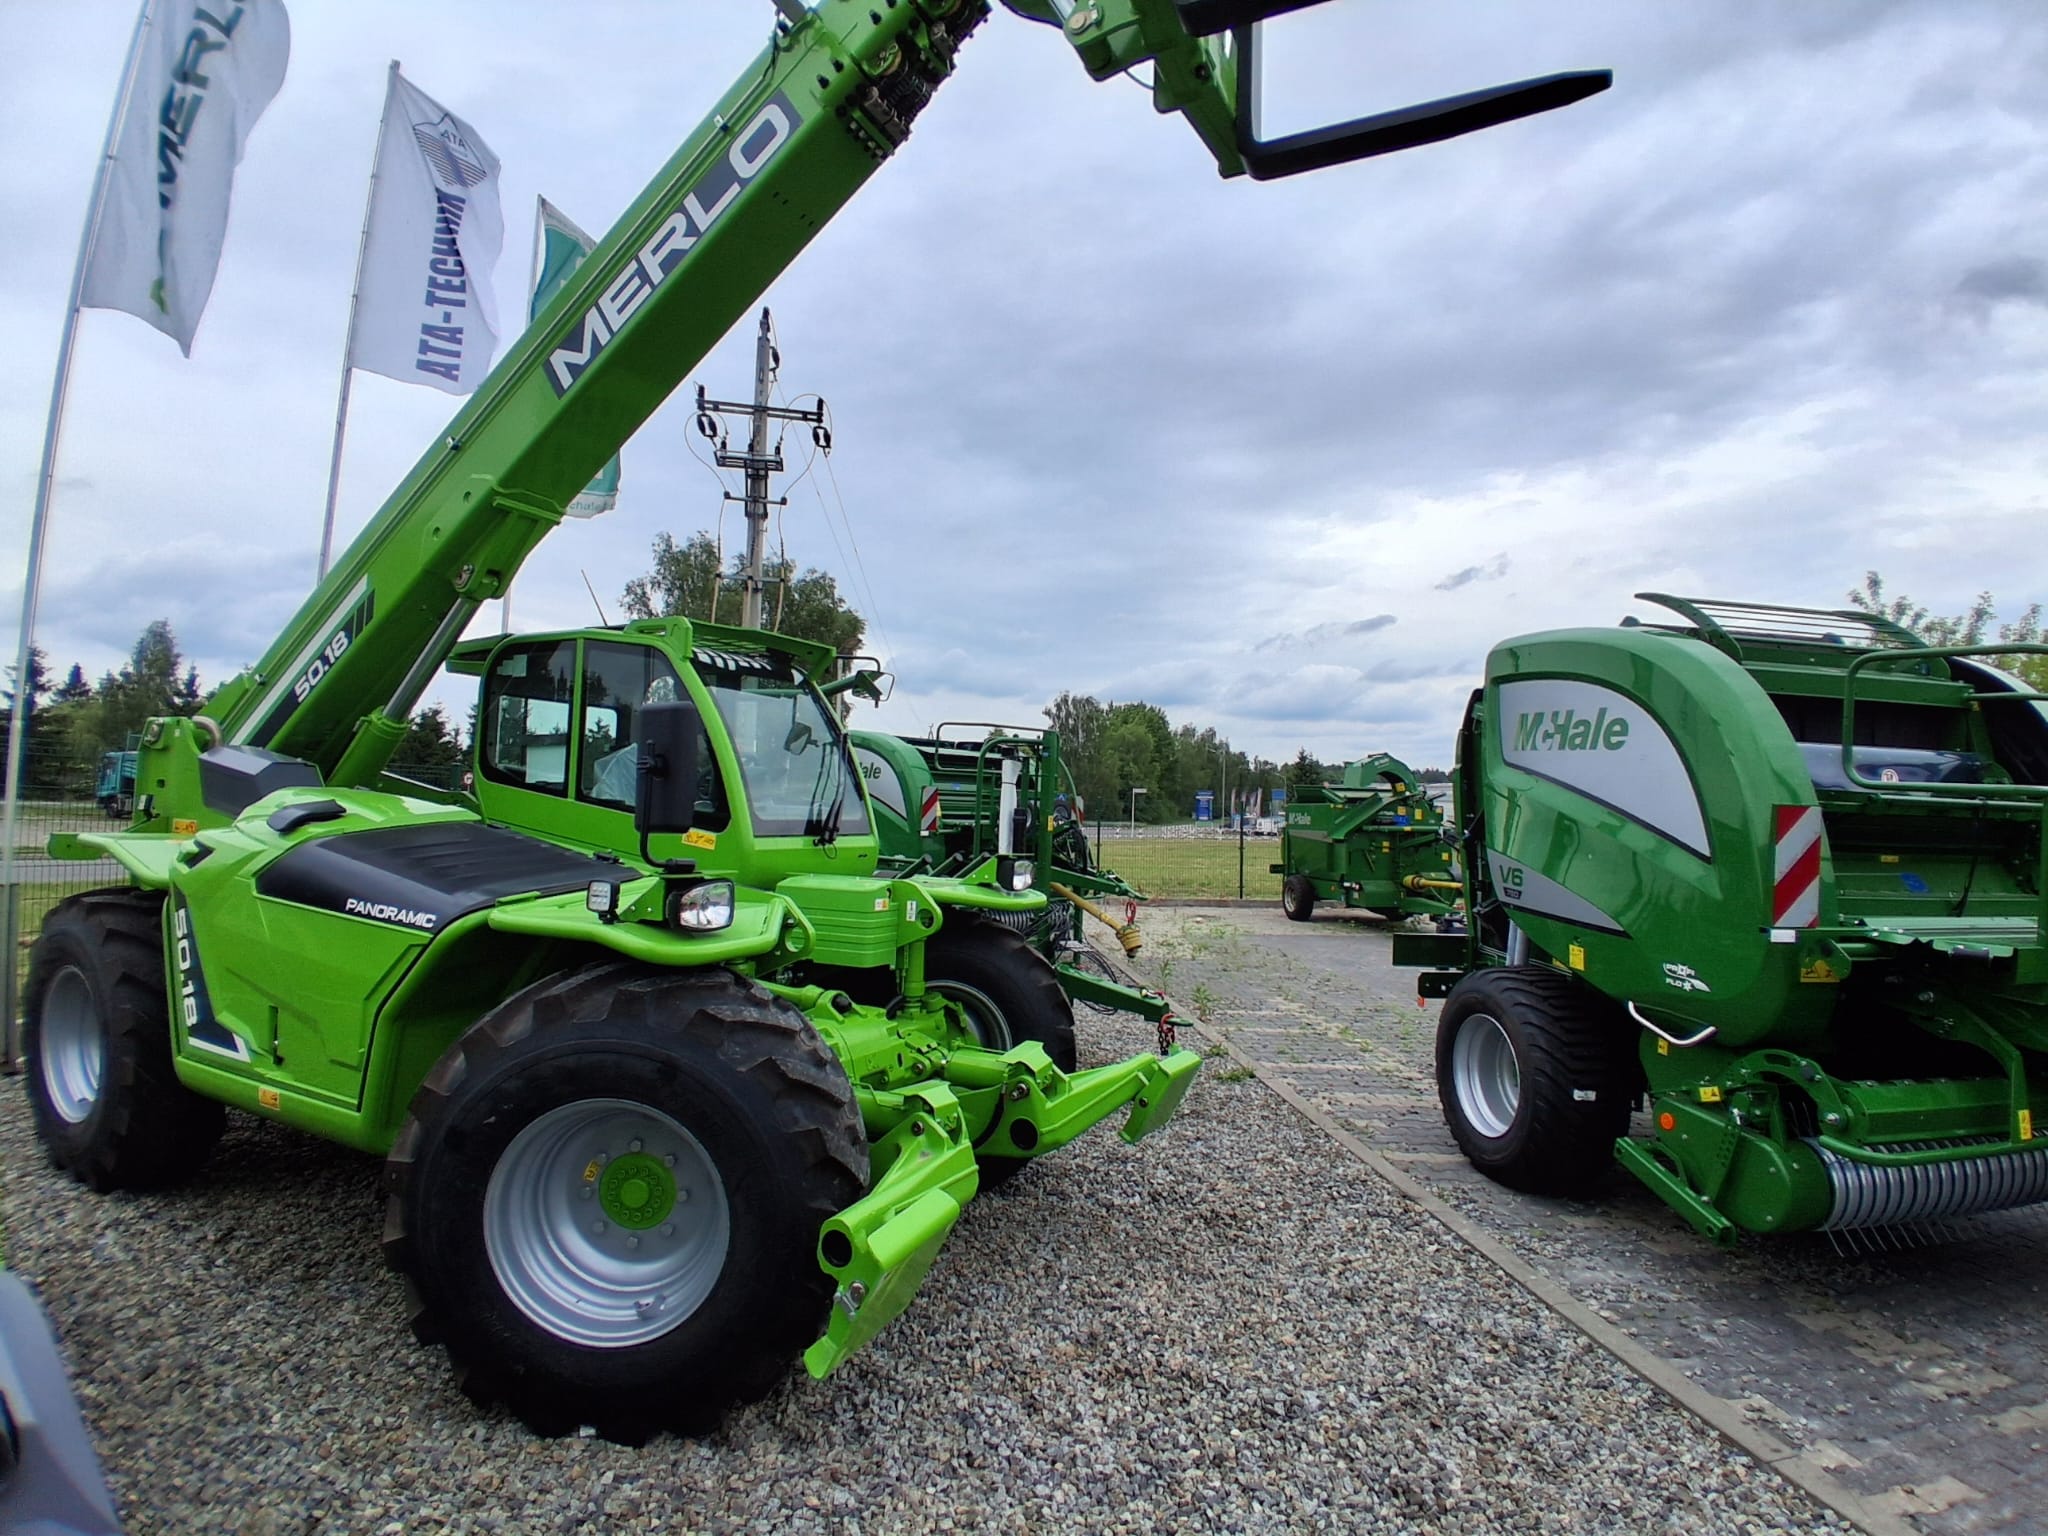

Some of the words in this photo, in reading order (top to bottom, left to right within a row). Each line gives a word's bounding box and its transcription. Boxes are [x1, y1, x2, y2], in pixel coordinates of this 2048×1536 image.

[158, 0, 246, 210] MERL
[440, 129, 467, 151] ATA
[548, 103, 791, 391] MERLO
[294, 630, 349, 703] 50.18
[1513, 706, 1630, 752] McHale
[1499, 864, 1524, 887] V6
[344, 897, 437, 929] PANORAMIC
[174, 907, 198, 1027] 50.18
